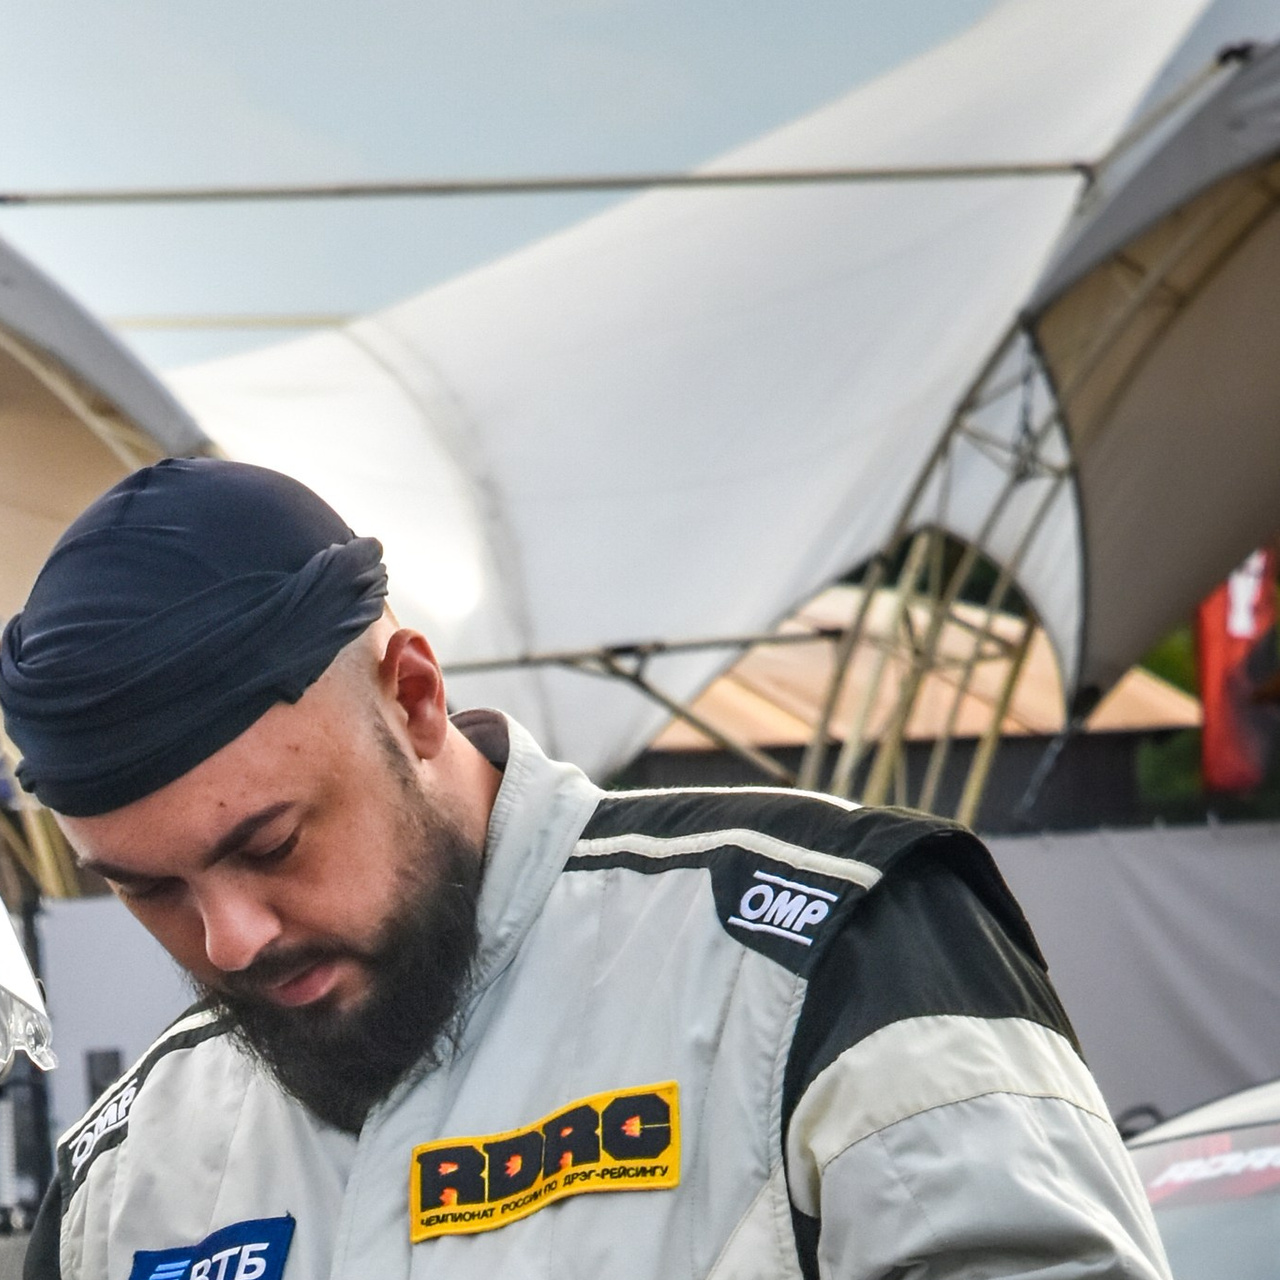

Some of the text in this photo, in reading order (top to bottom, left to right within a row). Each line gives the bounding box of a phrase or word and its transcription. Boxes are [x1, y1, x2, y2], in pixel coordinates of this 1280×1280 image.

[737, 881, 831, 935] OMP
[70, 1085, 138, 1169] OMP
[417, 1093, 671, 1212] RDRC
[420, 1207, 495, 1228] ЧЕМПИОНАТ
[543, 1179, 558, 1196] ПО
[563, 1165, 669, 1188] ДРЭГ-РЕЙСИНГУ
